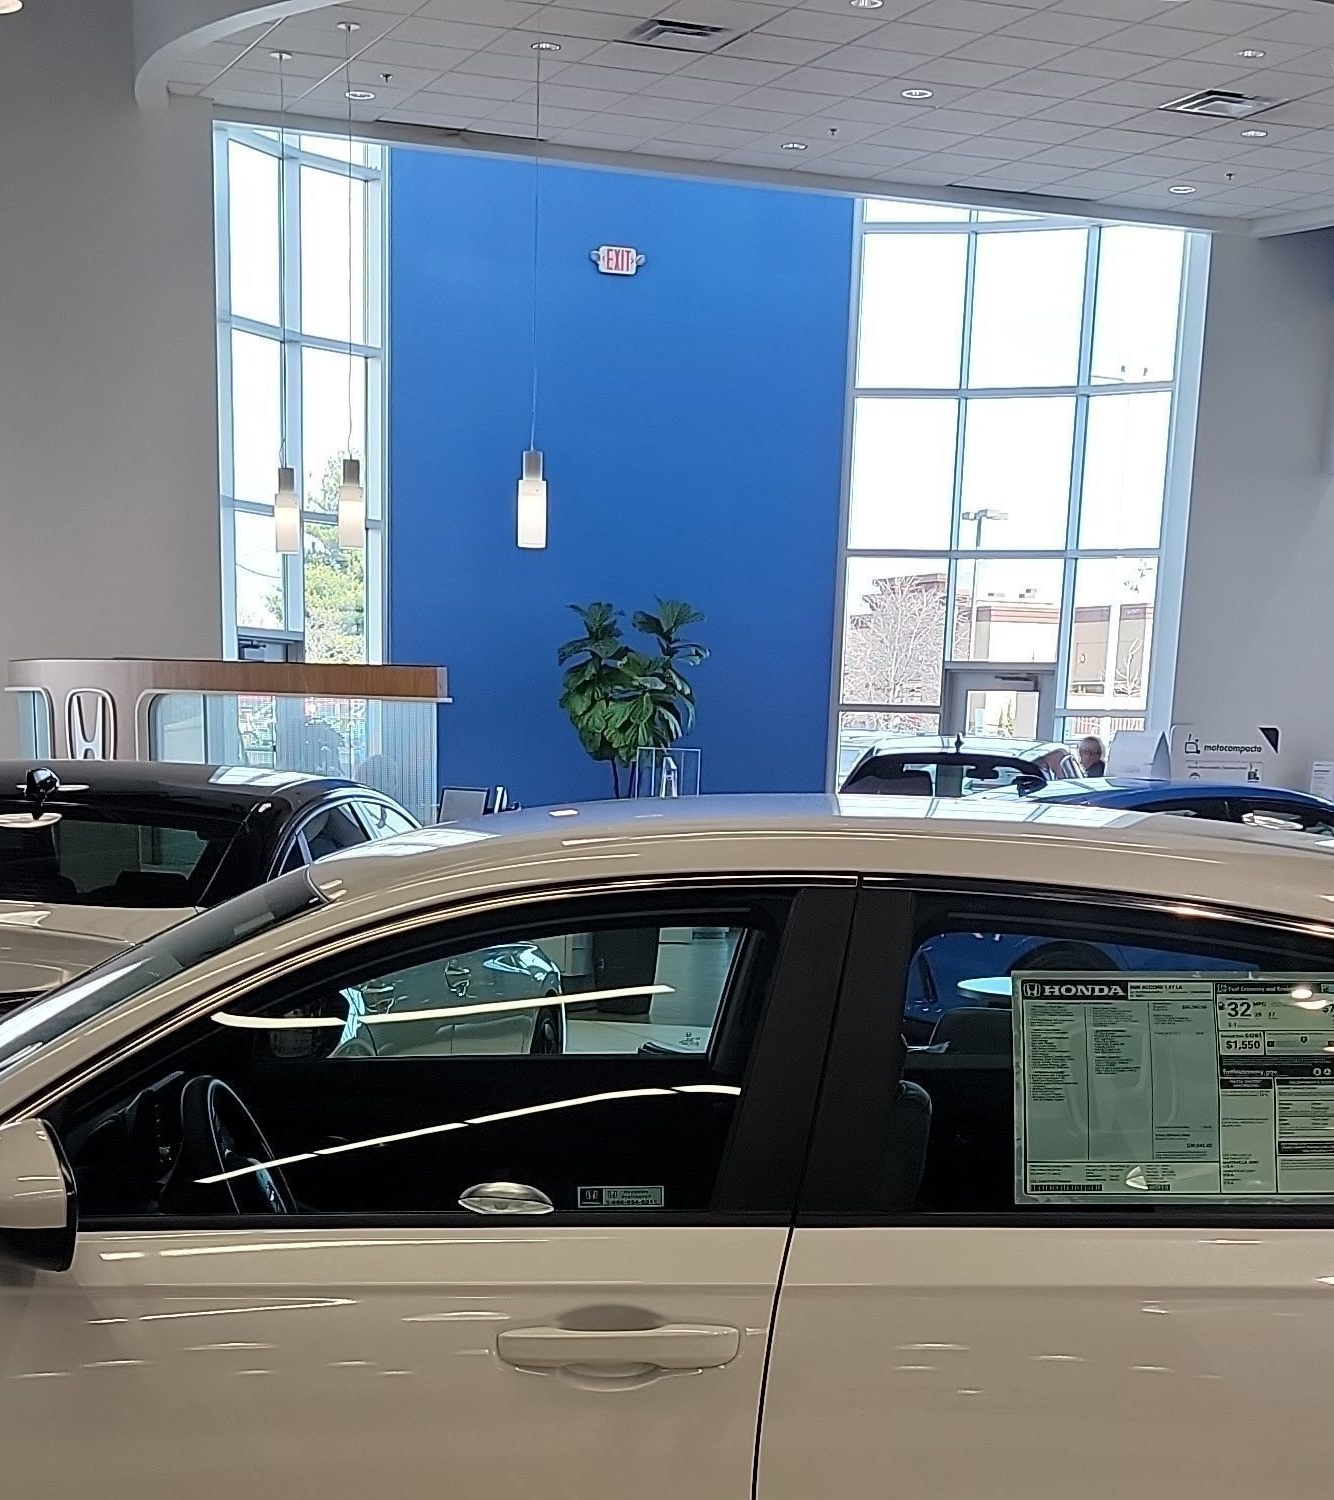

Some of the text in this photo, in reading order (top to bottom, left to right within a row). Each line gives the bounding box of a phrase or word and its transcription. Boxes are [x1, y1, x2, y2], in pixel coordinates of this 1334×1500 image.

[607, 249, 631, 271] EXIT
[1204, 744, 1262, 755] motocompacto
[1043, 984, 1127, 997] HONDA
[1227, 1001, 1252, 1018] 32
[1226, 1040, 1261, 1051] $1,550
